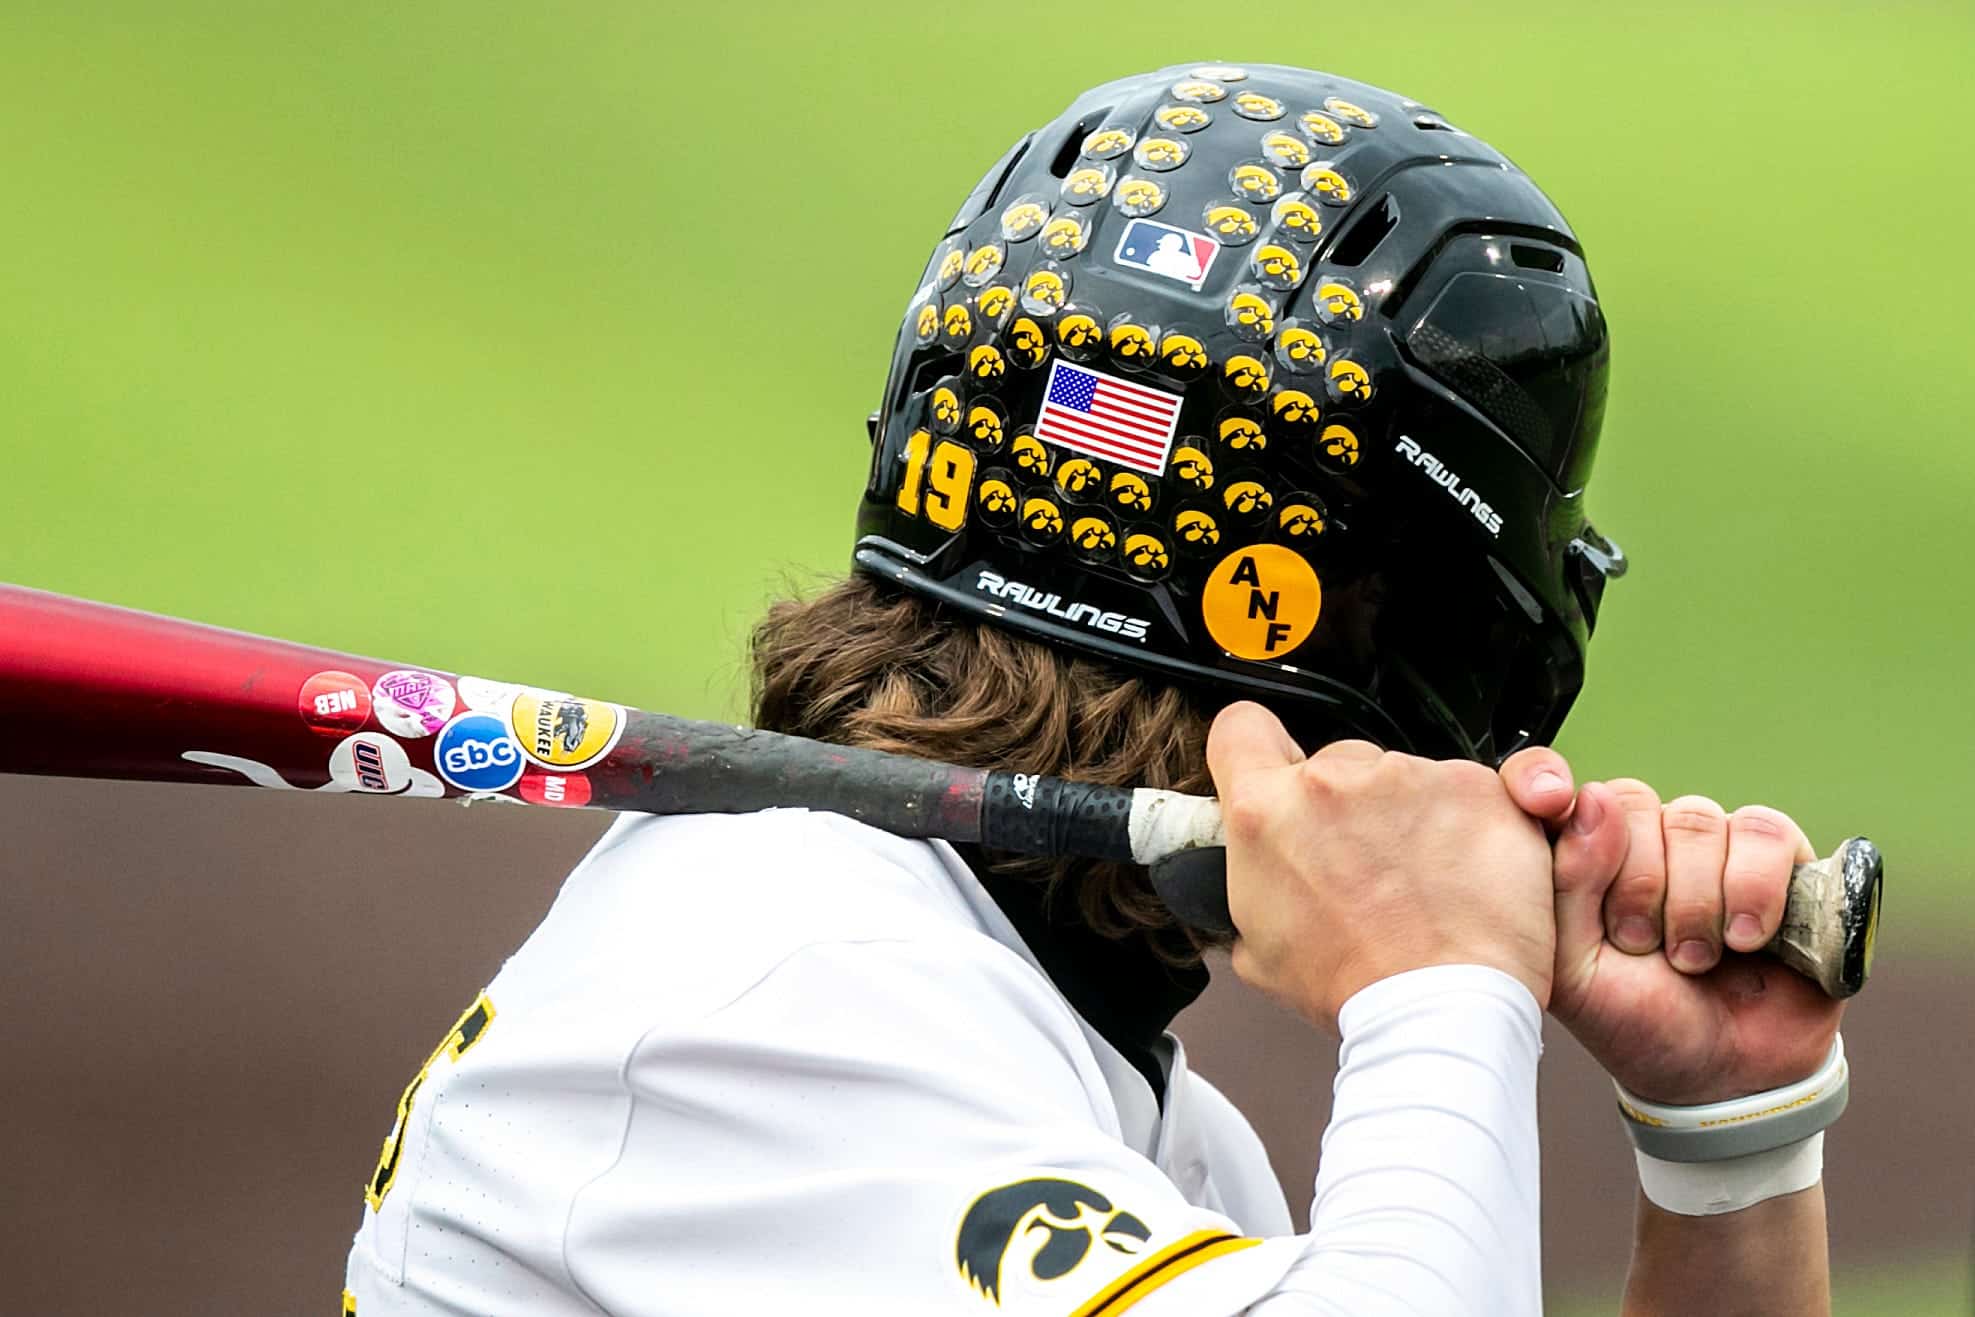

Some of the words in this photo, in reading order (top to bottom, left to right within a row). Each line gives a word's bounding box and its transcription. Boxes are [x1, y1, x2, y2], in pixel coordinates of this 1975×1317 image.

[896, 427, 978, 533] 19
[1395, 435, 1503, 536] RAWLINGS
[976, 570, 1153, 641] RAWLINGS
[313, 689, 357, 716] NEB
[536, 701, 555, 757] WAUKEE
[352, 740, 389, 791] UIC
[447, 738, 514, 770] sbc
[543, 776, 567, 802] MD
